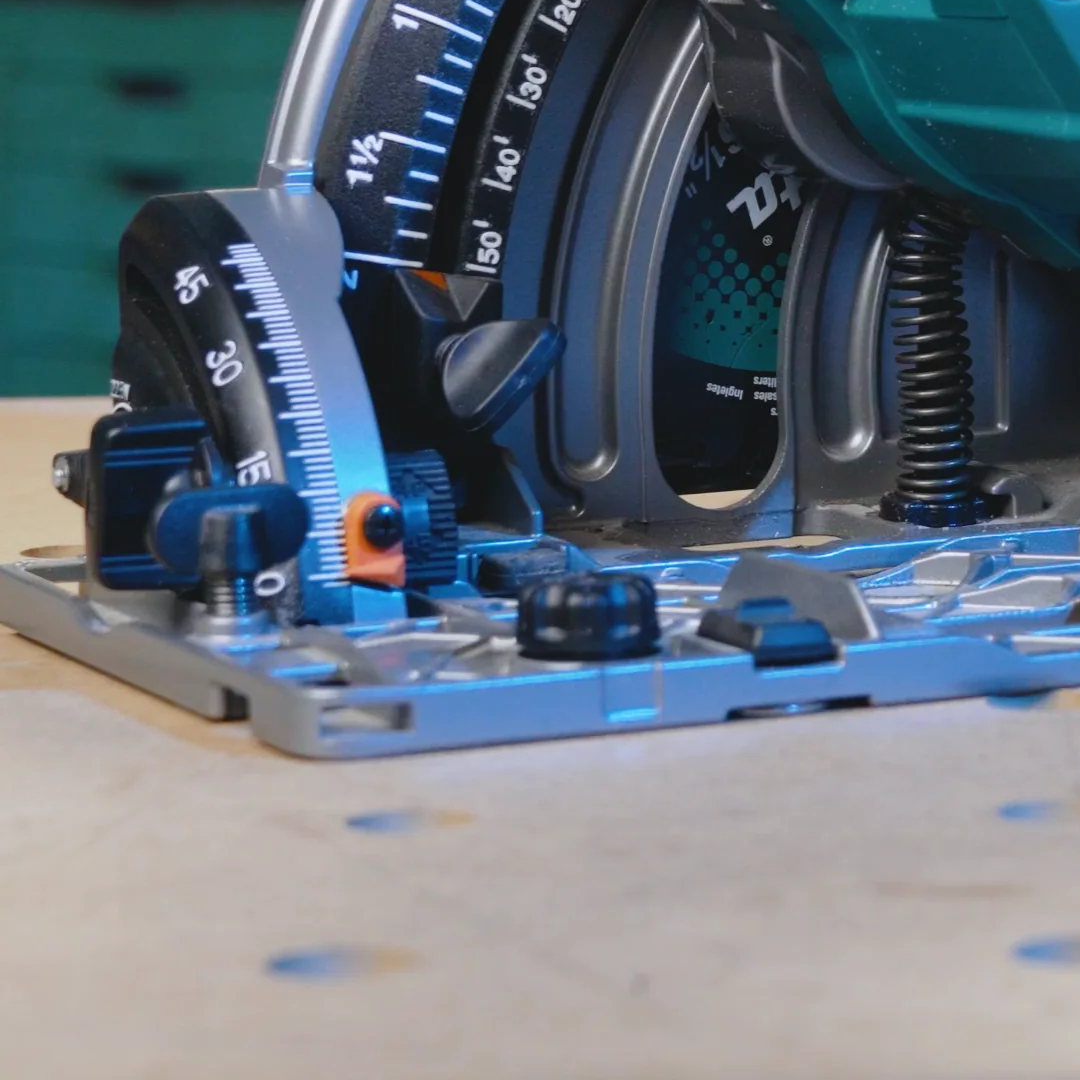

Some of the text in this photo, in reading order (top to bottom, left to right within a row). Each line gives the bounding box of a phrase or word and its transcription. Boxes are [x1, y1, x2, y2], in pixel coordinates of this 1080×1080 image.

[392, 13, 420, 30] 1
[519, 67, 548, 102] 30
[495, 148, 521, 184] 40
[478, 230, 502, 266] 50
[174, 264, 210, 305] 45
[205, 340, 244, 387] 30
[706, 382, 744, 400] Ingletes
[236, 450, 271, 488] 15
[254, 571, 286, 598] 0
